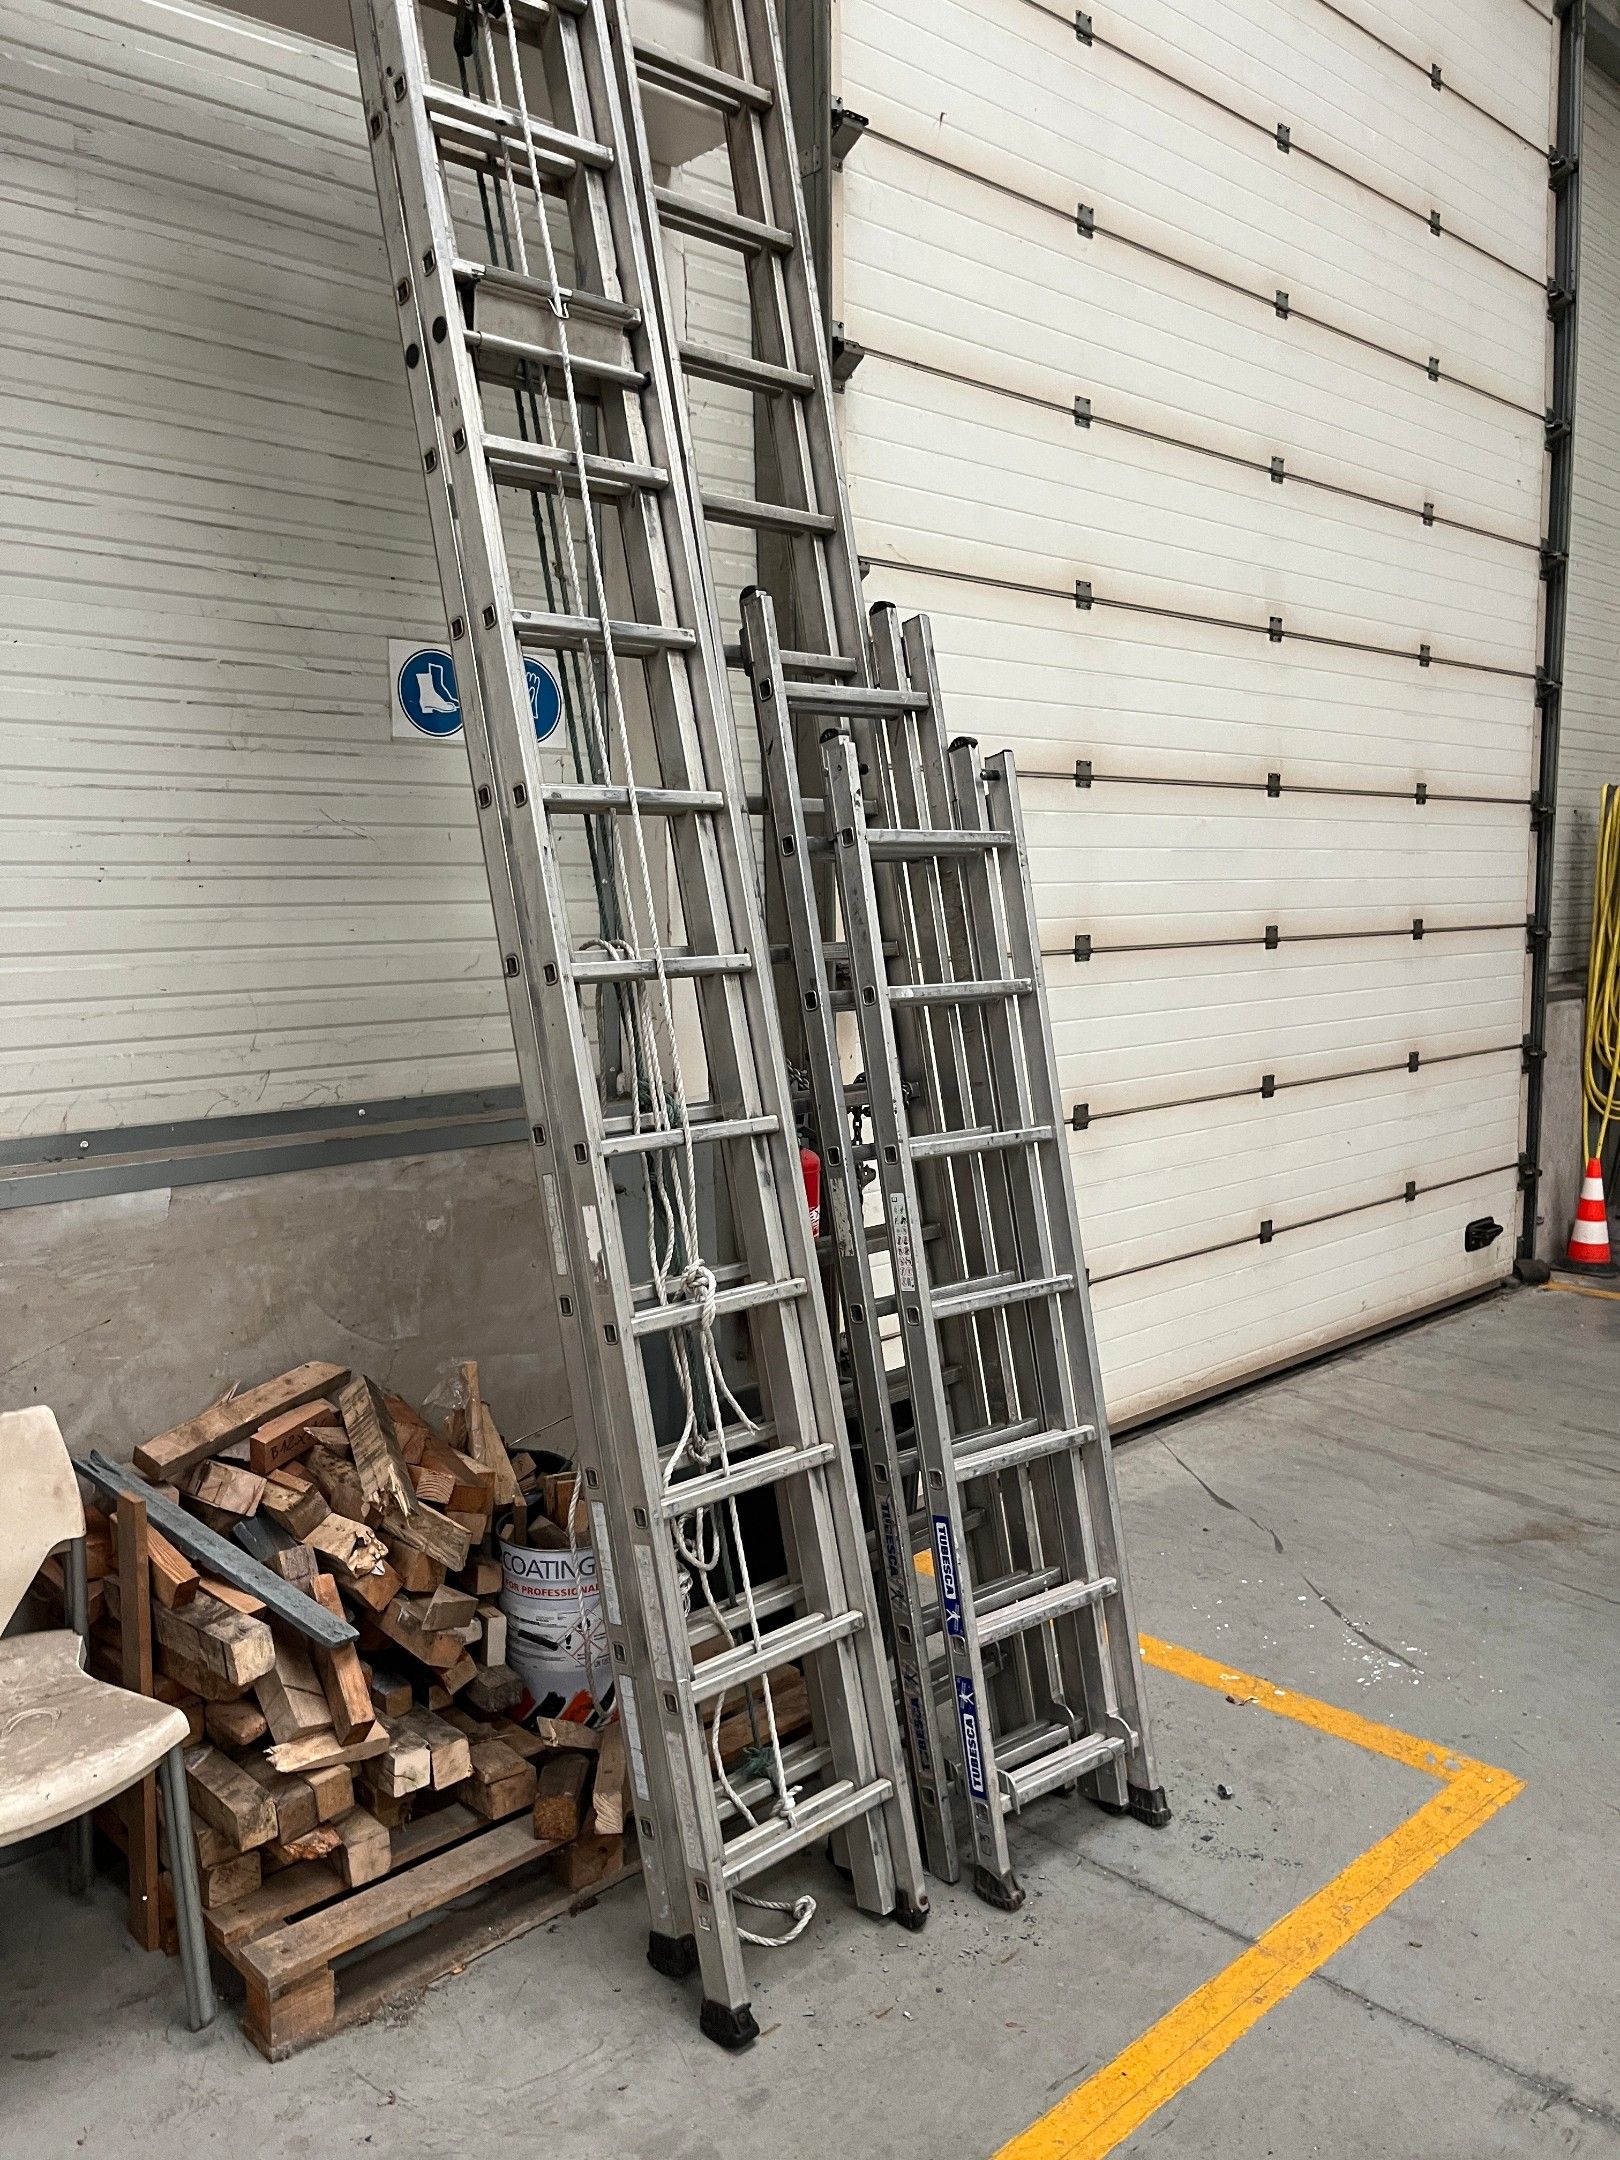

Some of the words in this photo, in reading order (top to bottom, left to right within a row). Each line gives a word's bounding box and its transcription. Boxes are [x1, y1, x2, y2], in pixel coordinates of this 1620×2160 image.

[503, 1550, 596, 1580] COATING
[504, 1580, 520, 1592] FOR
[937, 1523, 956, 1599] TUBESCA
[964, 1717, 984, 1792] TUBESCA
